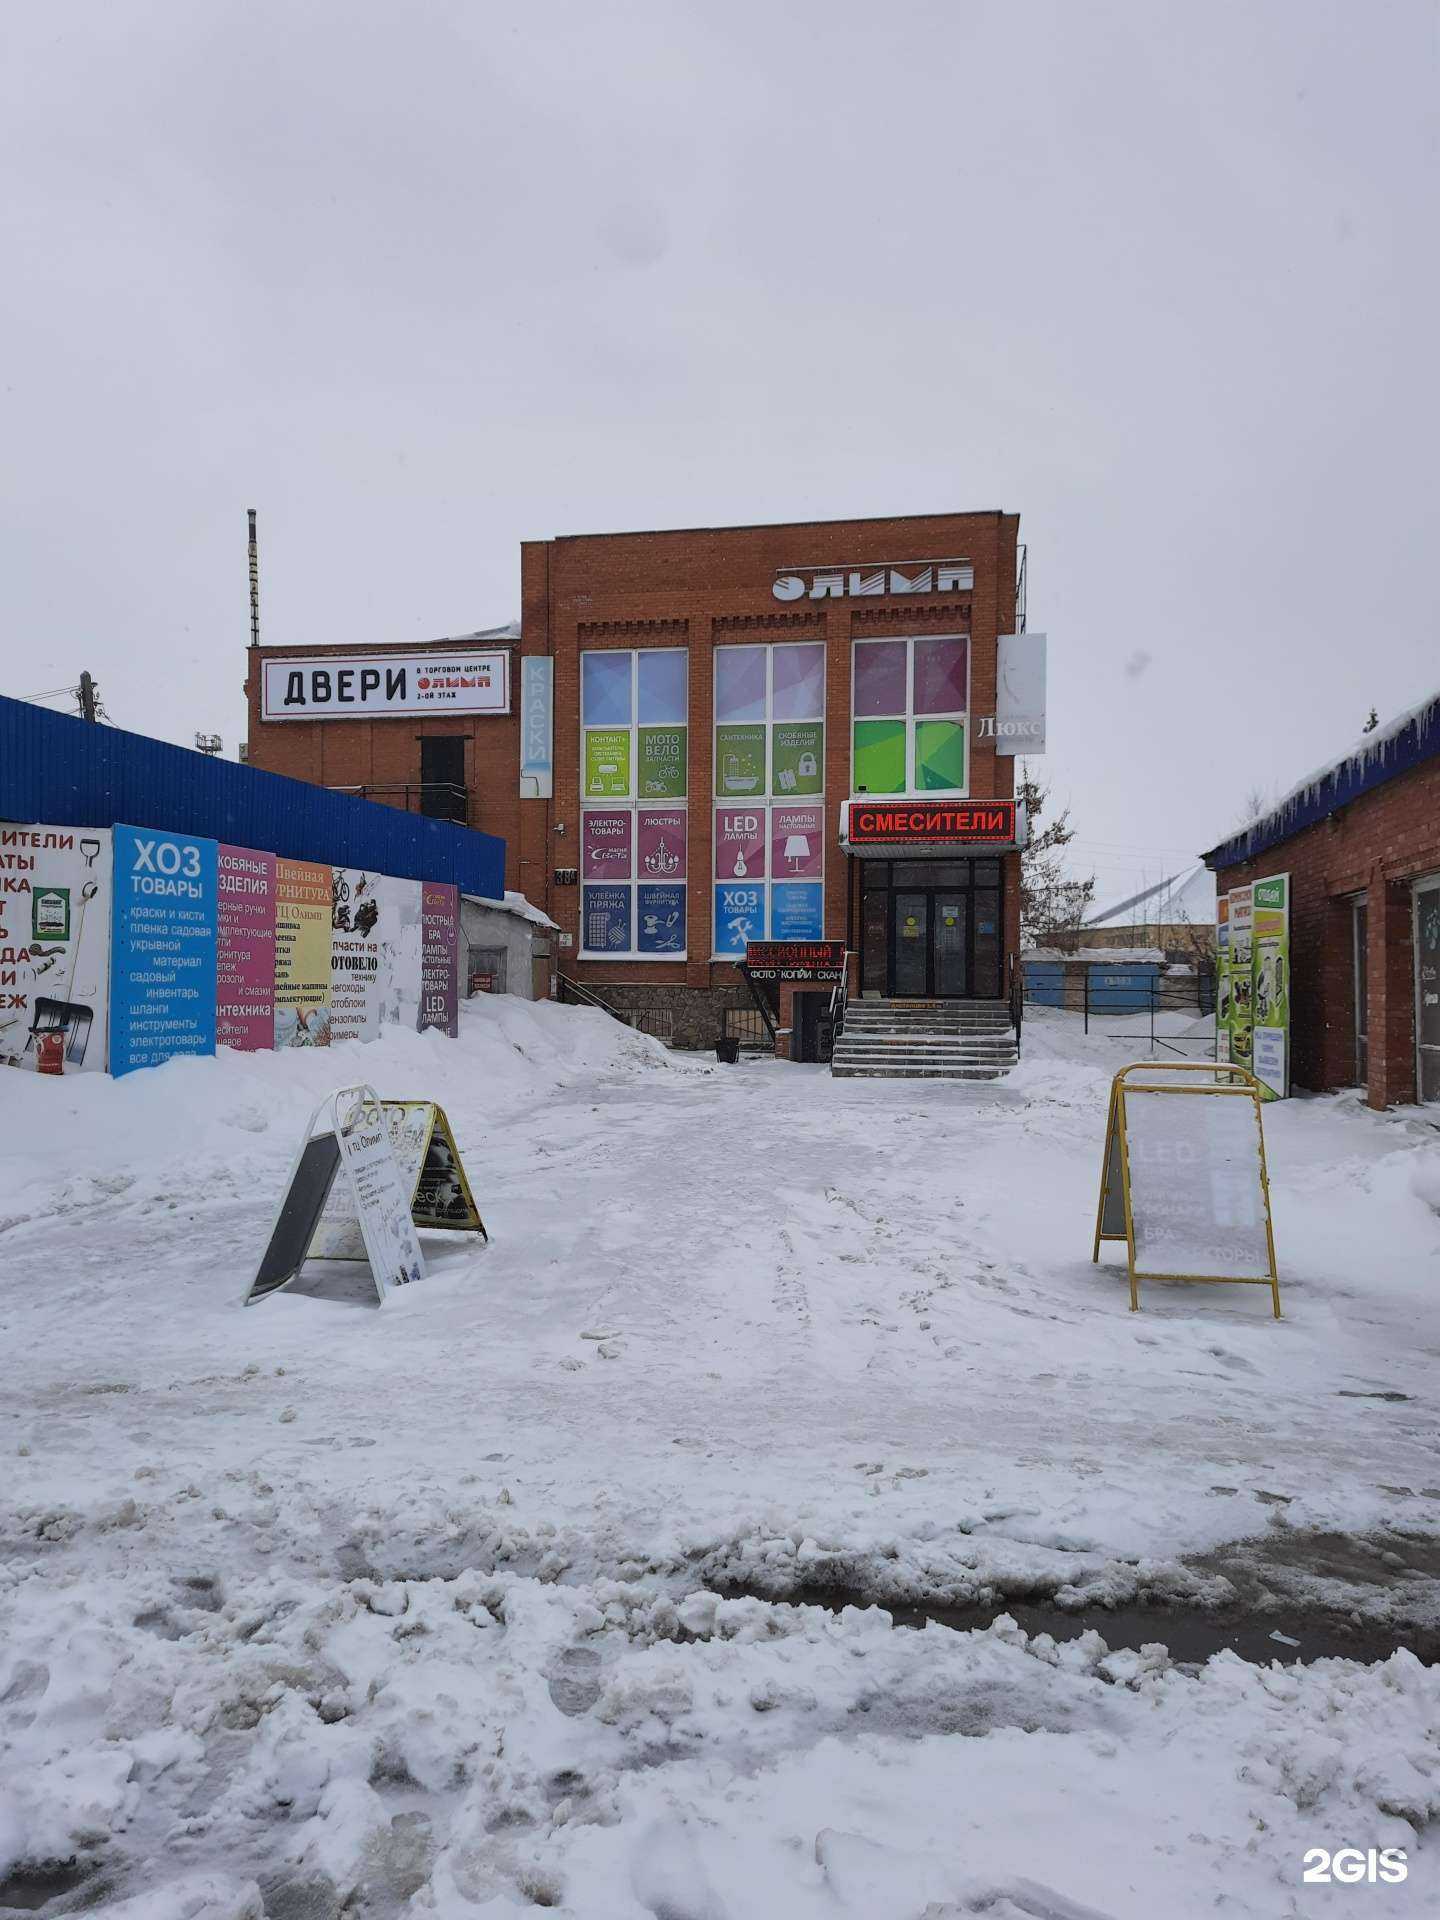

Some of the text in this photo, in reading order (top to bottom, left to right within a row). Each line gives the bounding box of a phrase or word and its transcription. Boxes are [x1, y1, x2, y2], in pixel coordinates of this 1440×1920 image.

[772, 566, 974, 601] ОЛИМП
[426, 665, 461, 674] ТОРГОВОМ
[465, 664, 491, 673] ЦЕНТРЕ
[284, 668, 406, 706] ДВЕРИ
[417, 676, 491, 690] ОЛИМП
[645, 734, 679, 745] МОТО
[645, 745, 679, 756] ВЕЛО
[644, 818, 681, 826] ЛЮСТРЫ
[724, 815, 758, 832] LED
[779, 814, 816, 823] ЛАМПЫ
[859, 812, 1003, 832] СМЕСИТЕЛИ
[724, 832, 757, 840] ЛАМПЫ
[132, 838, 201, 878] ХОЗ
[0, 878, 32, 893] КА
[130, 876, 203, 899] ТОВАРЫ
[589, 900, 624, 909] ПРЯЖА
[723, 890, 758, 906] ХОЗ
[130, 907, 205, 921] краски и кисти
[244, 904, 266, 916] ручки
[723, 906, 758, 914] ТОВАРЫ
[130, 923, 212, 938] пленка садовая
[217, 925, 273, 939] мплектующие
[429, 929, 441, 940] БРА
[130, 938, 181, 953] укрывной
[368, 944, 378, 952] на
[153, 956, 202, 970] материал
[331, 956, 378, 970] ОТОВЕЛО
[130, 970, 176, 984] садовый
[351, 973, 377, 984] технику
[751, 970, 776, 979] ФОТО
[146, 987, 200, 999] инвентарь
[245, 986, 271, 996] смазки
[130, 1003, 169, 1015] шланги
[426, 996, 445, 1012] LED
[422, 1012, 449, 1024] ЛАМПЫ
[130, 1019, 199, 1034] инструменты
[129, 1033, 207, 1049] электротовары
[129, 1053, 148, 1064] все
